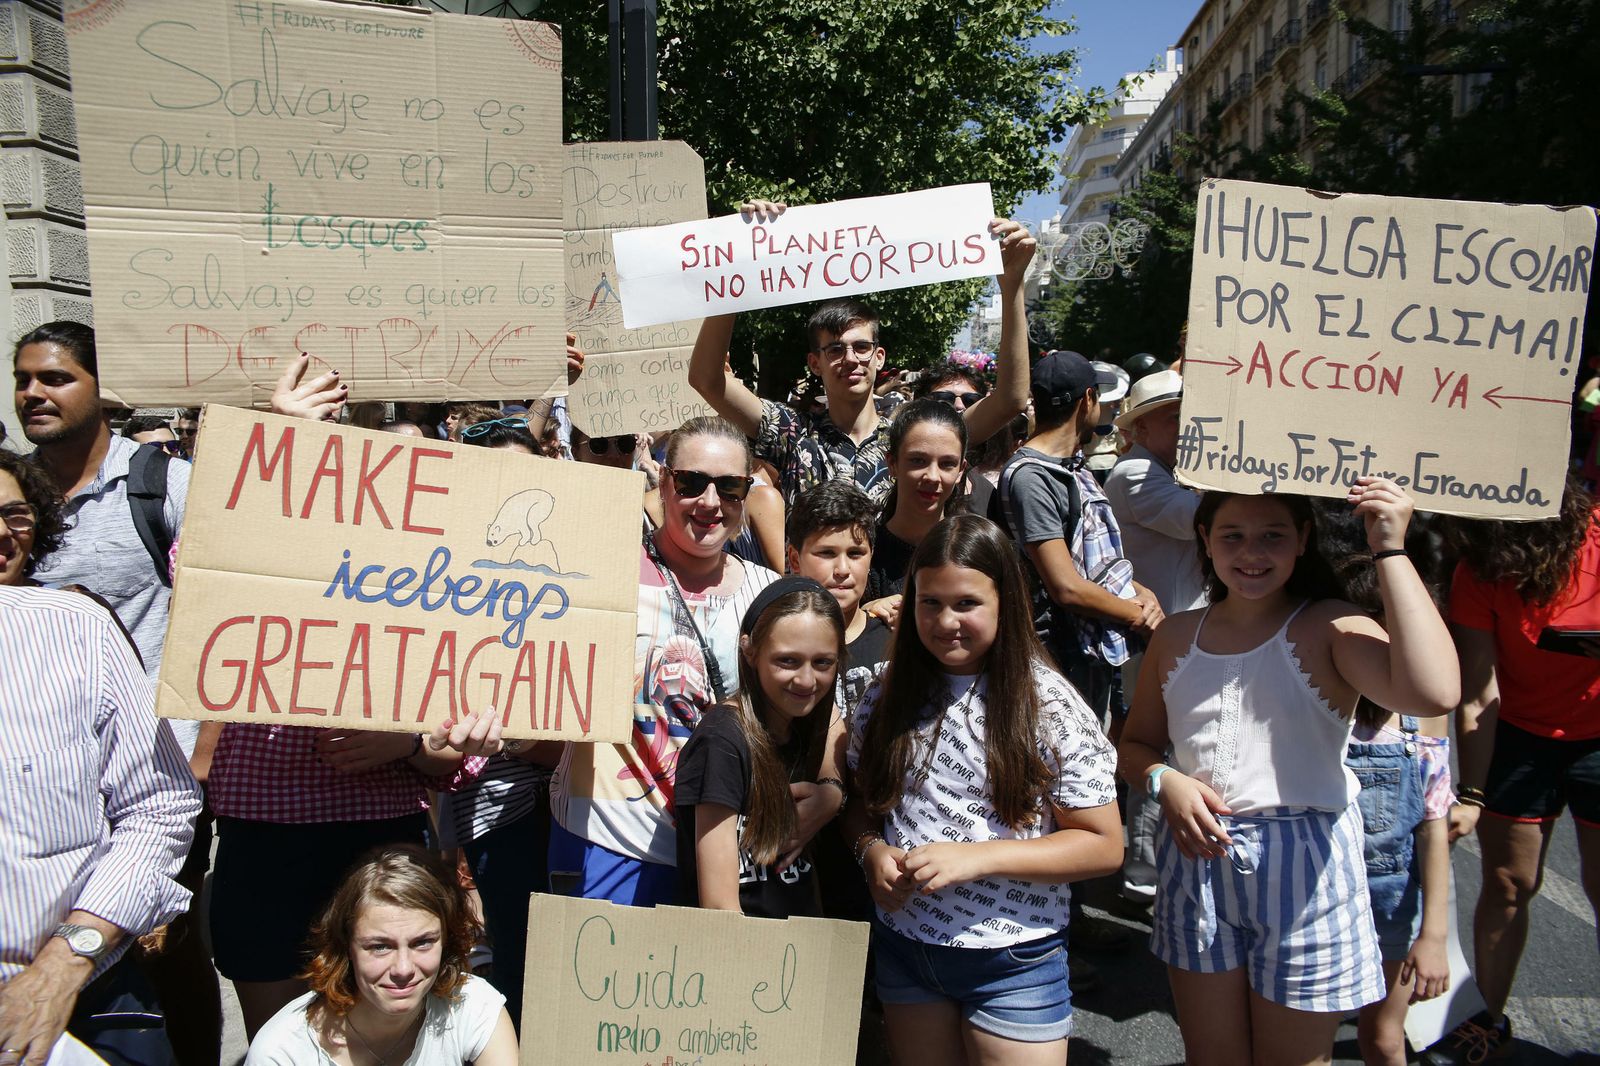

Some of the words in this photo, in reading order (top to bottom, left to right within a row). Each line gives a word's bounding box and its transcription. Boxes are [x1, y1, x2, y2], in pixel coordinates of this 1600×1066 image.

[135, 20, 370, 134] Salvaje
[404, 98, 445, 121] no
[474, 99, 525, 135] es
[129, 132, 261, 206] quien
[287, 139, 370, 181] vive
[400, 153, 445, 191] en
[485, 138, 536, 198] los
[562, 160, 688, 208] Destruir
[566, 207, 590, 246] el
[681, 234, 734, 271] SIN
[751, 225, 887, 260] PLANETA
[1433, 223, 1593, 294] ESCOLAR
[704, 272, 745, 302] NO
[760, 261, 814, 292] HAY
[823, 233, 987, 288] CORPUS
[121, 247, 316, 323] Salvaje
[345, 284, 383, 307] es
[405, 278, 498, 320] quien
[516, 261, 557, 307] los
[1214, 275, 1292, 334] POR
[1315, 294, 1371, 339] EL
[1390, 303, 1580, 377] CLIMA!
[165, 316, 537, 391] DESTRUYE
[1246, 340, 1404, 397] ACCIÓN
[1432, 367, 1470, 410] YA
[582, 388, 640, 408] rama
[589, 409, 624, 435] nos
[225, 421, 454, 537] MAKE
[322, 546, 570, 650] icebergs
[947, 735, 968, 754] PWR
[937, 752, 954, 769] GRL
[951, 762, 975, 782] PWR
[1079, 754, 1097, 768] PWR
[936, 783, 949, 795] GRL
[946, 789, 963, 802] PWR
[966, 784, 983, 798] GRL
[1087, 778, 1104, 792] GRL
[903, 814, 918, 832] PWR
[918, 808, 927, 818] GRL
[925, 813, 938, 823] PWR
[937, 802, 952, 819] GRL
[952, 812, 976, 830] PWR
[966, 802, 989, 819] GRL
[941, 826, 961, 842] GRL
[954, 885, 974, 902] GRL
[971, 893, 996, 909] PWR
[984, 880, 1001, 892] PWR
[1006, 888, 1026, 904] GRL
[1023, 893, 1049, 909] PWR
[882, 912, 897, 929] GRL
[912, 897, 931, 913] GRL
[928, 906, 954, 925] PWR
[953, 904, 964, 913] GRL
[961, 909, 976, 918] PWR
[998, 906, 1009, 914] GRL
[1006, 908, 1019, 916] PWR
[1029, 914, 1042, 923] GRL
[1039, 917, 1055, 926] PWR
[919, 923, 939, 938] GRL
[981, 917, 1002, 931] GRL
[1000, 923, 1023, 937] PWR
[573, 914, 708, 1010] Cuida
[751, 943, 797, 1014] el
[596, 1014, 661, 1056] medio
[678, 1018, 759, 1056] ambiente
